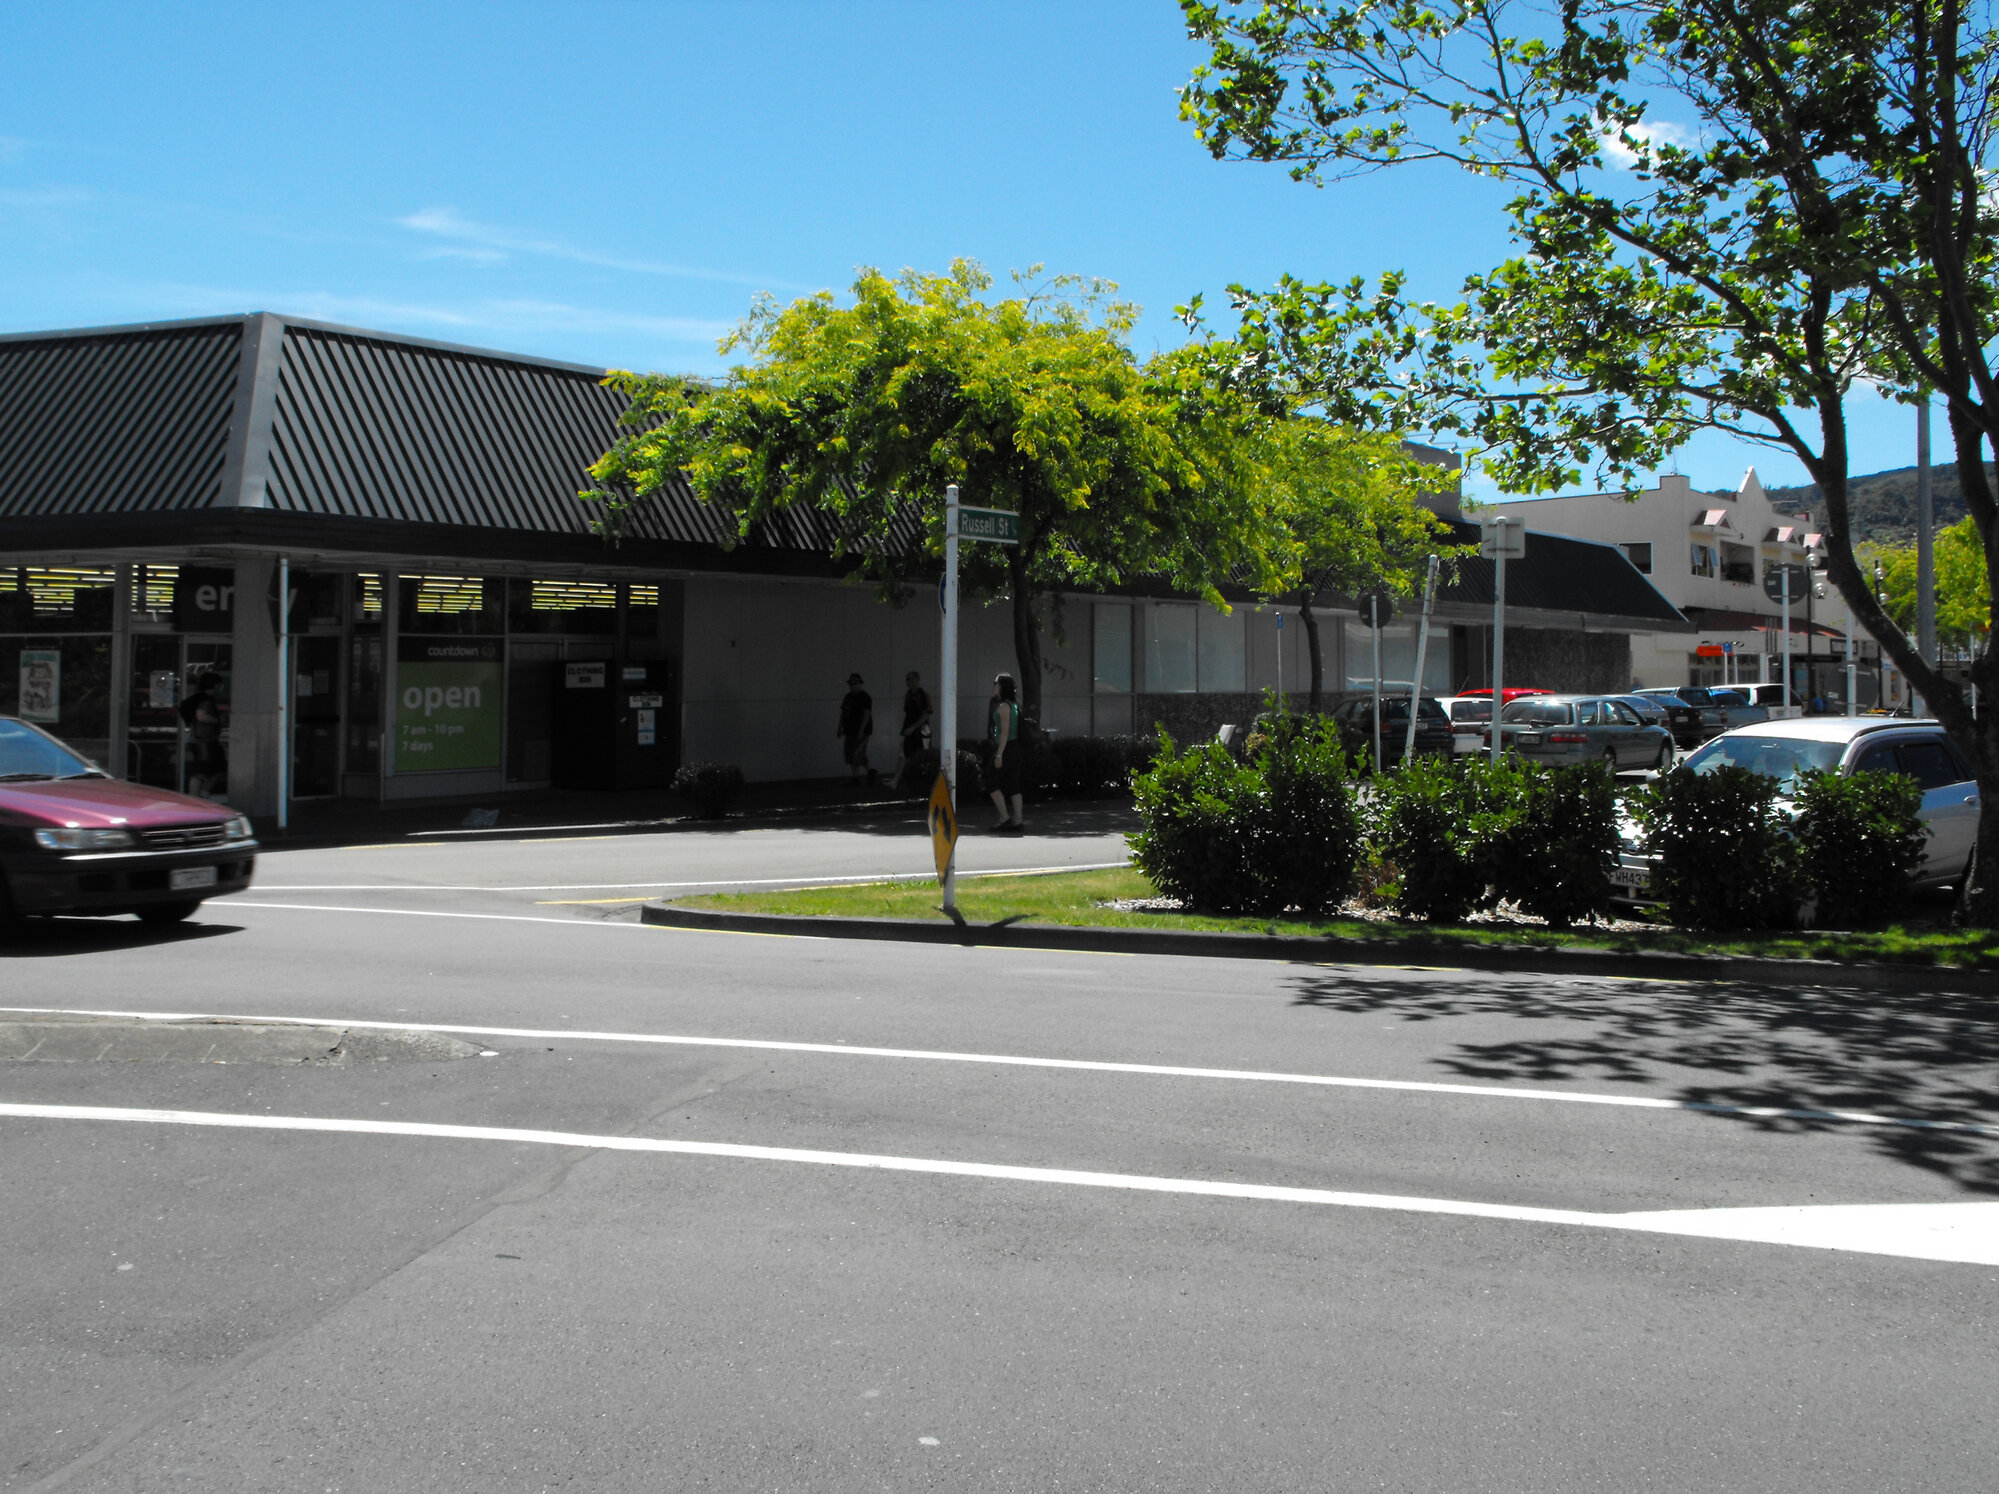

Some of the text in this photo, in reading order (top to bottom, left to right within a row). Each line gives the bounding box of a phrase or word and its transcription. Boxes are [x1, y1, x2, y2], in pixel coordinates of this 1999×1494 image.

[961, 513, 1009, 536] Russell St
[427, 645, 480, 657] countdown
[567, 667, 603, 675] CLOTHING
[403, 686, 481, 717] open
[402, 725, 409, 735] 7
[411, 726, 427, 735] am
[434, 724, 447, 735] 10
[448, 726, 464, 737] pm
[402, 740, 434, 753] 7 days
